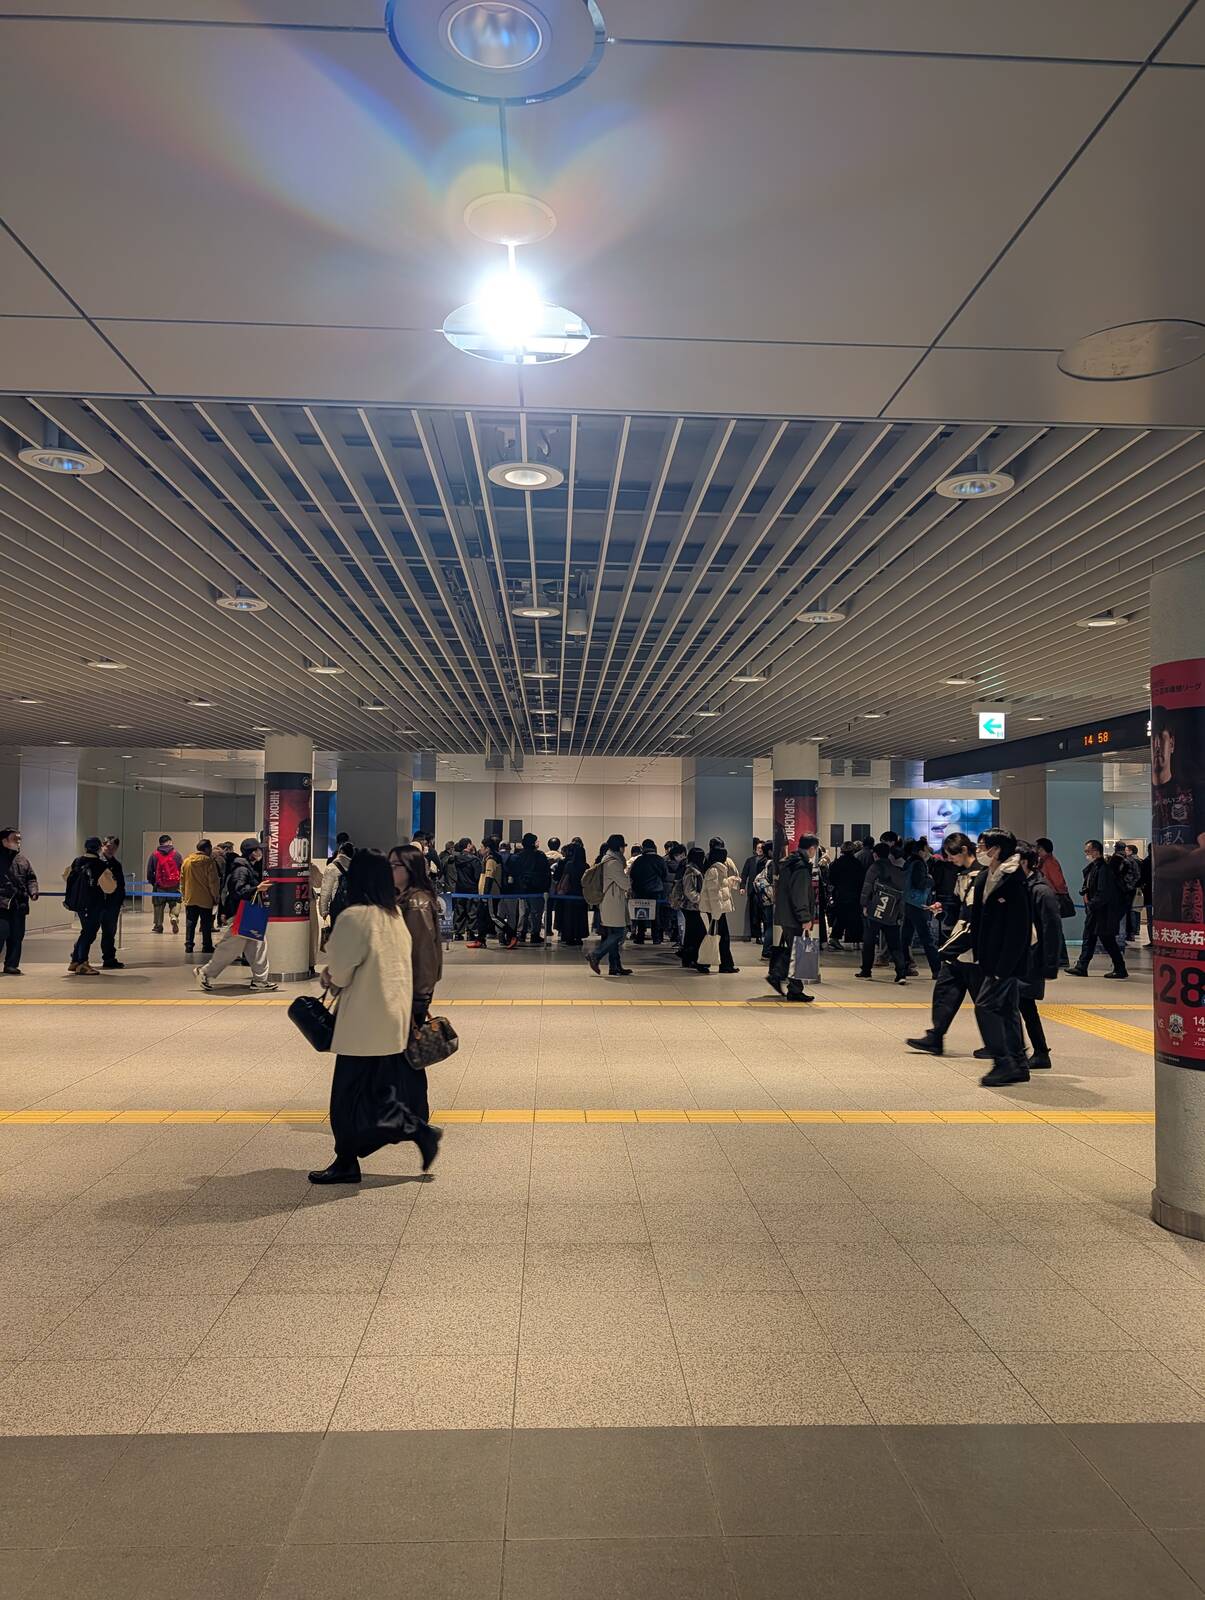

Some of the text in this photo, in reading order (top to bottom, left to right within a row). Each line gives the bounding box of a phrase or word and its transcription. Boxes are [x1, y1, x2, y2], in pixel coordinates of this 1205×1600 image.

[1084, 731, 1109, 746] 14 58
[268, 791, 280, 868] HIROKI MIYAZAWA
[784, 798, 796, 842] SUPACHOK
[874, 895, 890, 919] FILA
